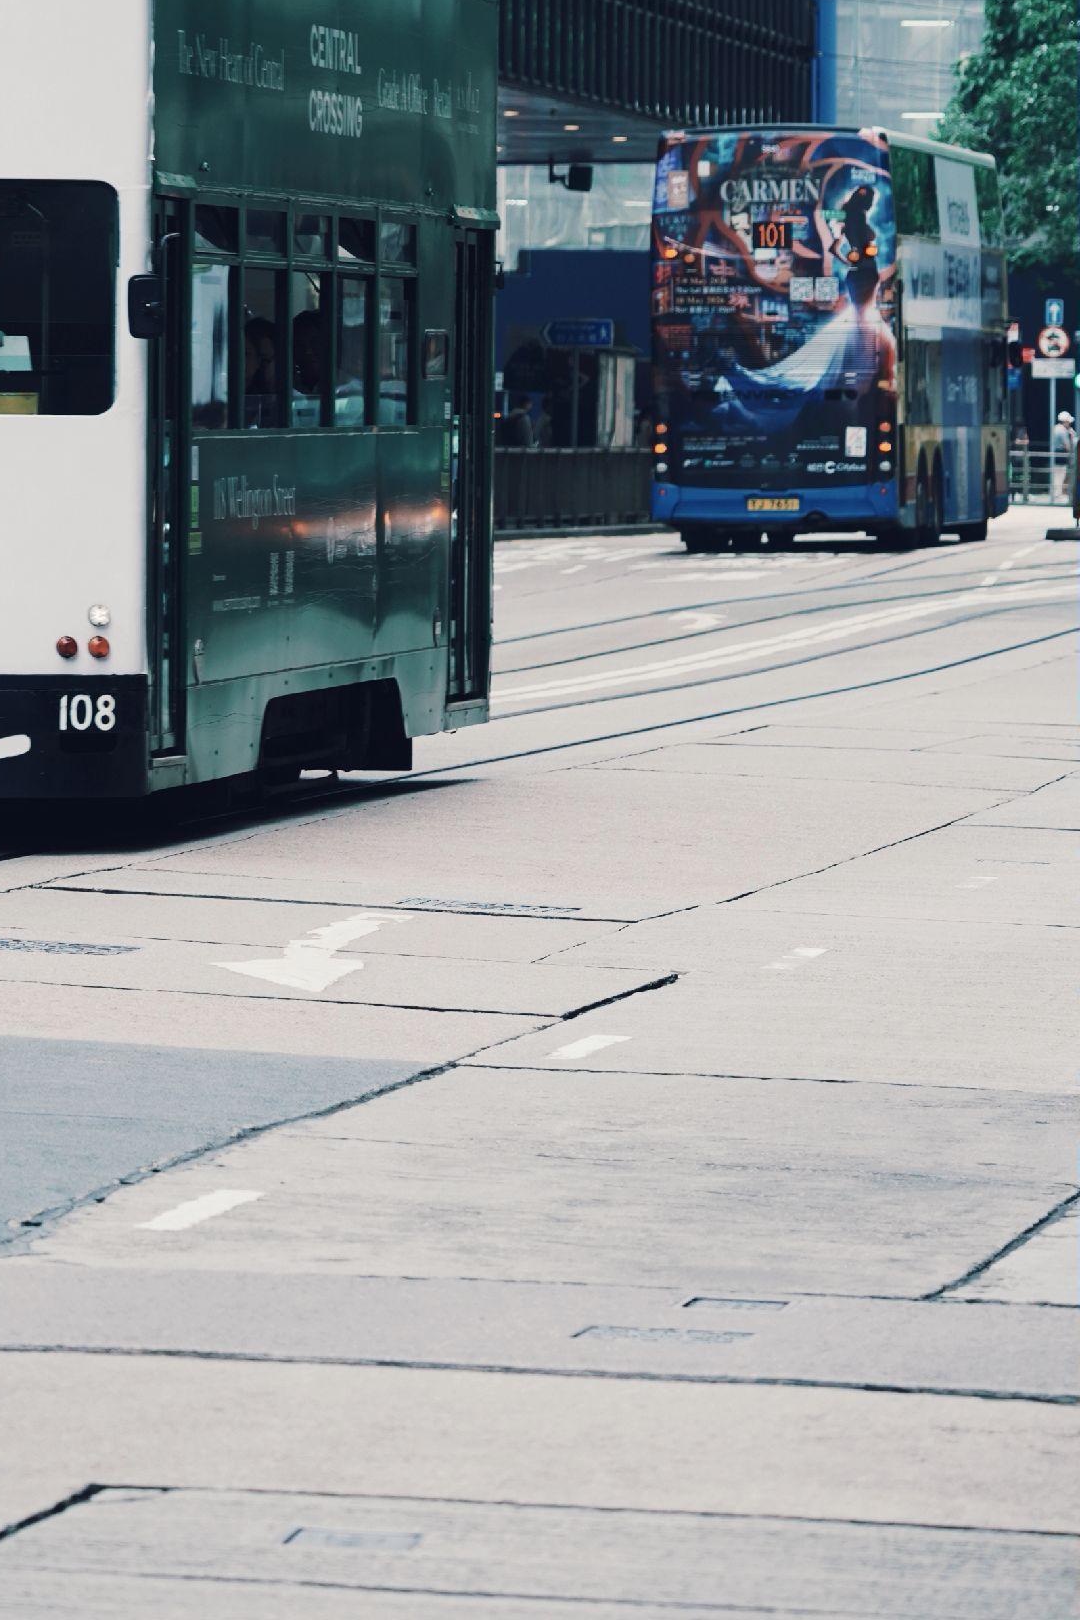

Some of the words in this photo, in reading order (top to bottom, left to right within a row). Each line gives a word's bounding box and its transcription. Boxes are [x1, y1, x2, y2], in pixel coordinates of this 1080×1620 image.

[310, 24, 362, 74] CENTRAL
[309, 89, 363, 138] CROSSING
[720, 178, 821, 203] CARMEN
[759, 222, 786, 248] 101
[58, 694, 117, 731] 108
